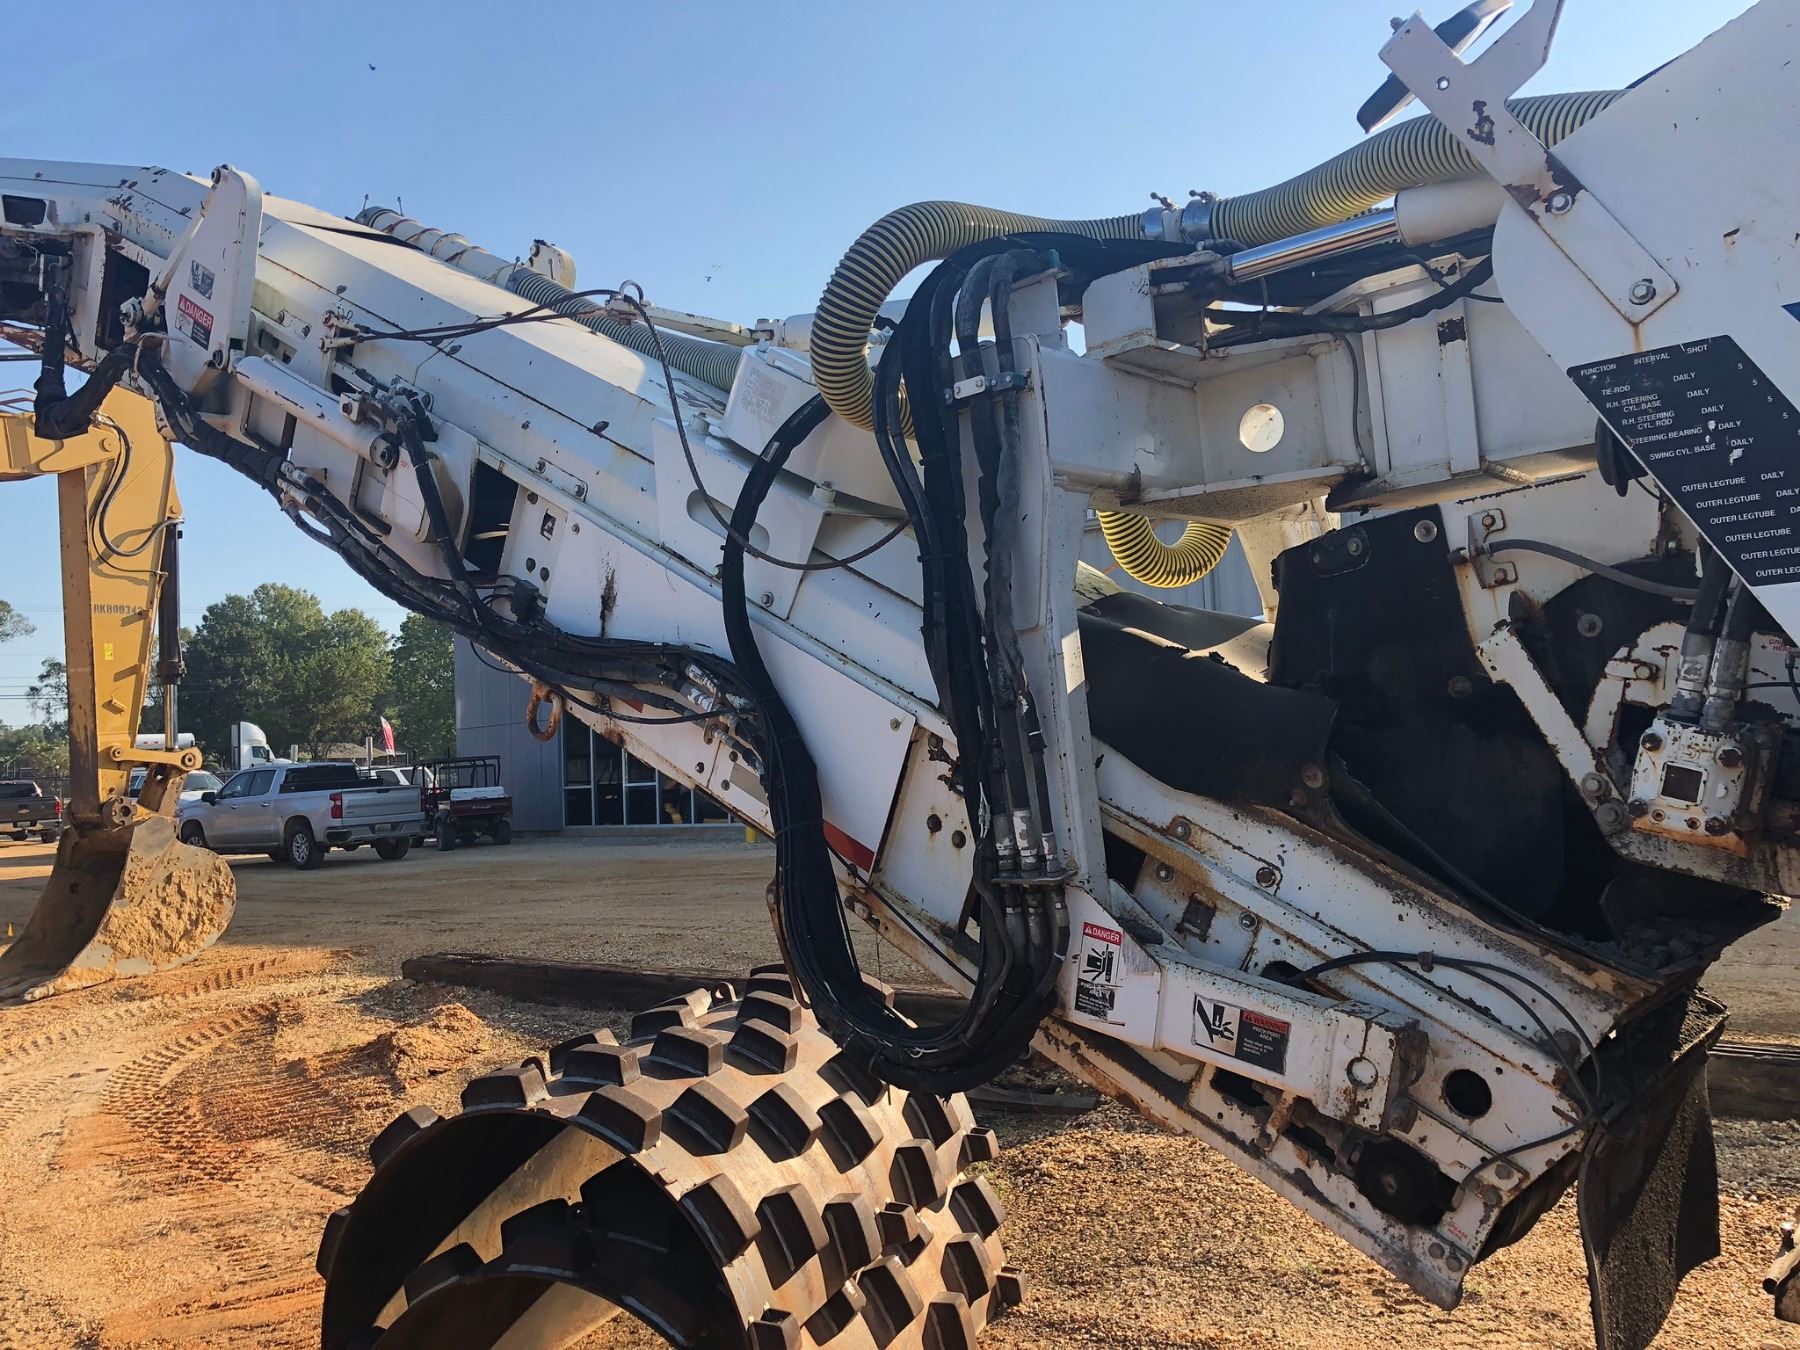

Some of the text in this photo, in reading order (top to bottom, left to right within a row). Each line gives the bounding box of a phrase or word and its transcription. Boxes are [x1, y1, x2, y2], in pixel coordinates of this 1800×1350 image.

[185, 303, 212, 329] DANGER
[1580, 344, 1708, 376] FUNCTION INTERVAL SHOT
[1601, 385, 1631, 395] TIE-ROD
[1673, 372, 1696, 382] DAILY
[1606, 400, 1620, 409] R.H.
[1621, 393, 1659, 406] STEERING
[1687, 388, 1710, 398] DAILY
[1623, 400, 1662, 413] CYL. BASE
[1622, 418, 1636, 426] R.H.
[1637, 410, 1675, 423] STEERING
[1701, 404, 1725, 414] DAILY
[1656, 418, 1673, 427] ROD
[1630, 432, 1667, 444] STEERING
[1668, 427, 1703, 439] BEARING
[1718, 420, 1741, 430] DAILY
[1649, 450, 1674, 460] SWING
[1694, 443, 1716, 454] BASE
[1731, 437, 1754, 447] DAILY
[1681, 471, 1785, 492] OUTER LEGTUBE DAILY
[1696, 488, 1800, 509] OUTER LEGTUBE DAILY
[1710, 510, 1776, 525] OUTER LEGTUBE
[1725, 528, 1792, 543] OUTER LEGTUBE
[1741, 546, 1800, 561] OUTER LEGTUB
[1756, 567, 1783, 578] OUTER
[1092, 927, 1120, 943] DANGER
[1252, 1014, 1286, 1031] WARNING
